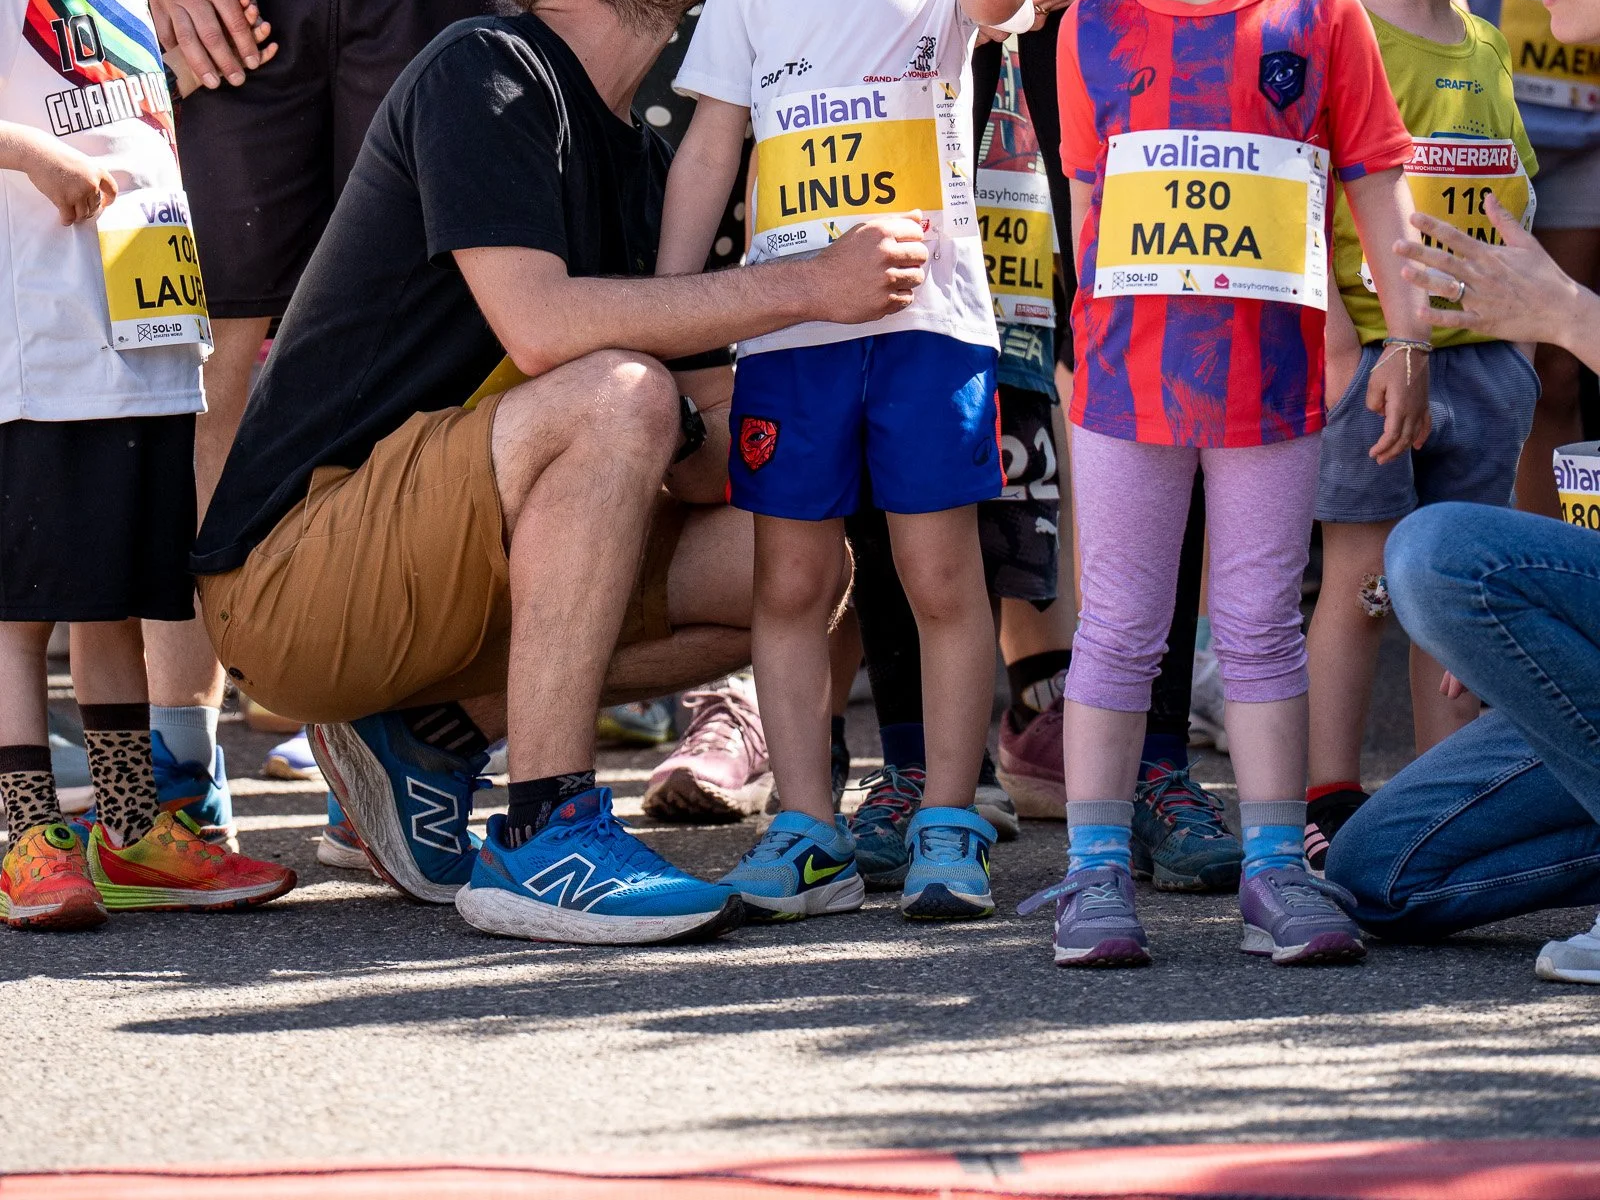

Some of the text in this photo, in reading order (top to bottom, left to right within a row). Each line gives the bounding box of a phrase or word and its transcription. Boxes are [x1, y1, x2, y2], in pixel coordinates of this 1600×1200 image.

[50, 13, 106, 72] 10
[863, 75, 892, 83] GRAND
[1435, 78, 1474, 91] CRAFT
[776, 90, 888, 131] valiant
[800, 132, 863, 167] 117
[945, 143, 961, 151] 117
[1142, 135, 1260, 172] valiant
[1404, 145, 1509, 168] ÄRNERBÄR
[140, 194, 189, 224] valia
[779, 171, 896, 218] LINUS
[1164, 179, 1232, 211] 180
[952, 217, 969, 226] 117
[1131, 222, 1263, 260] MARA
[985, 254, 1044, 289] RELL
[1231, 281, 1292, 295] easyhomes.ch
[135, 275, 207, 310] LAUR
